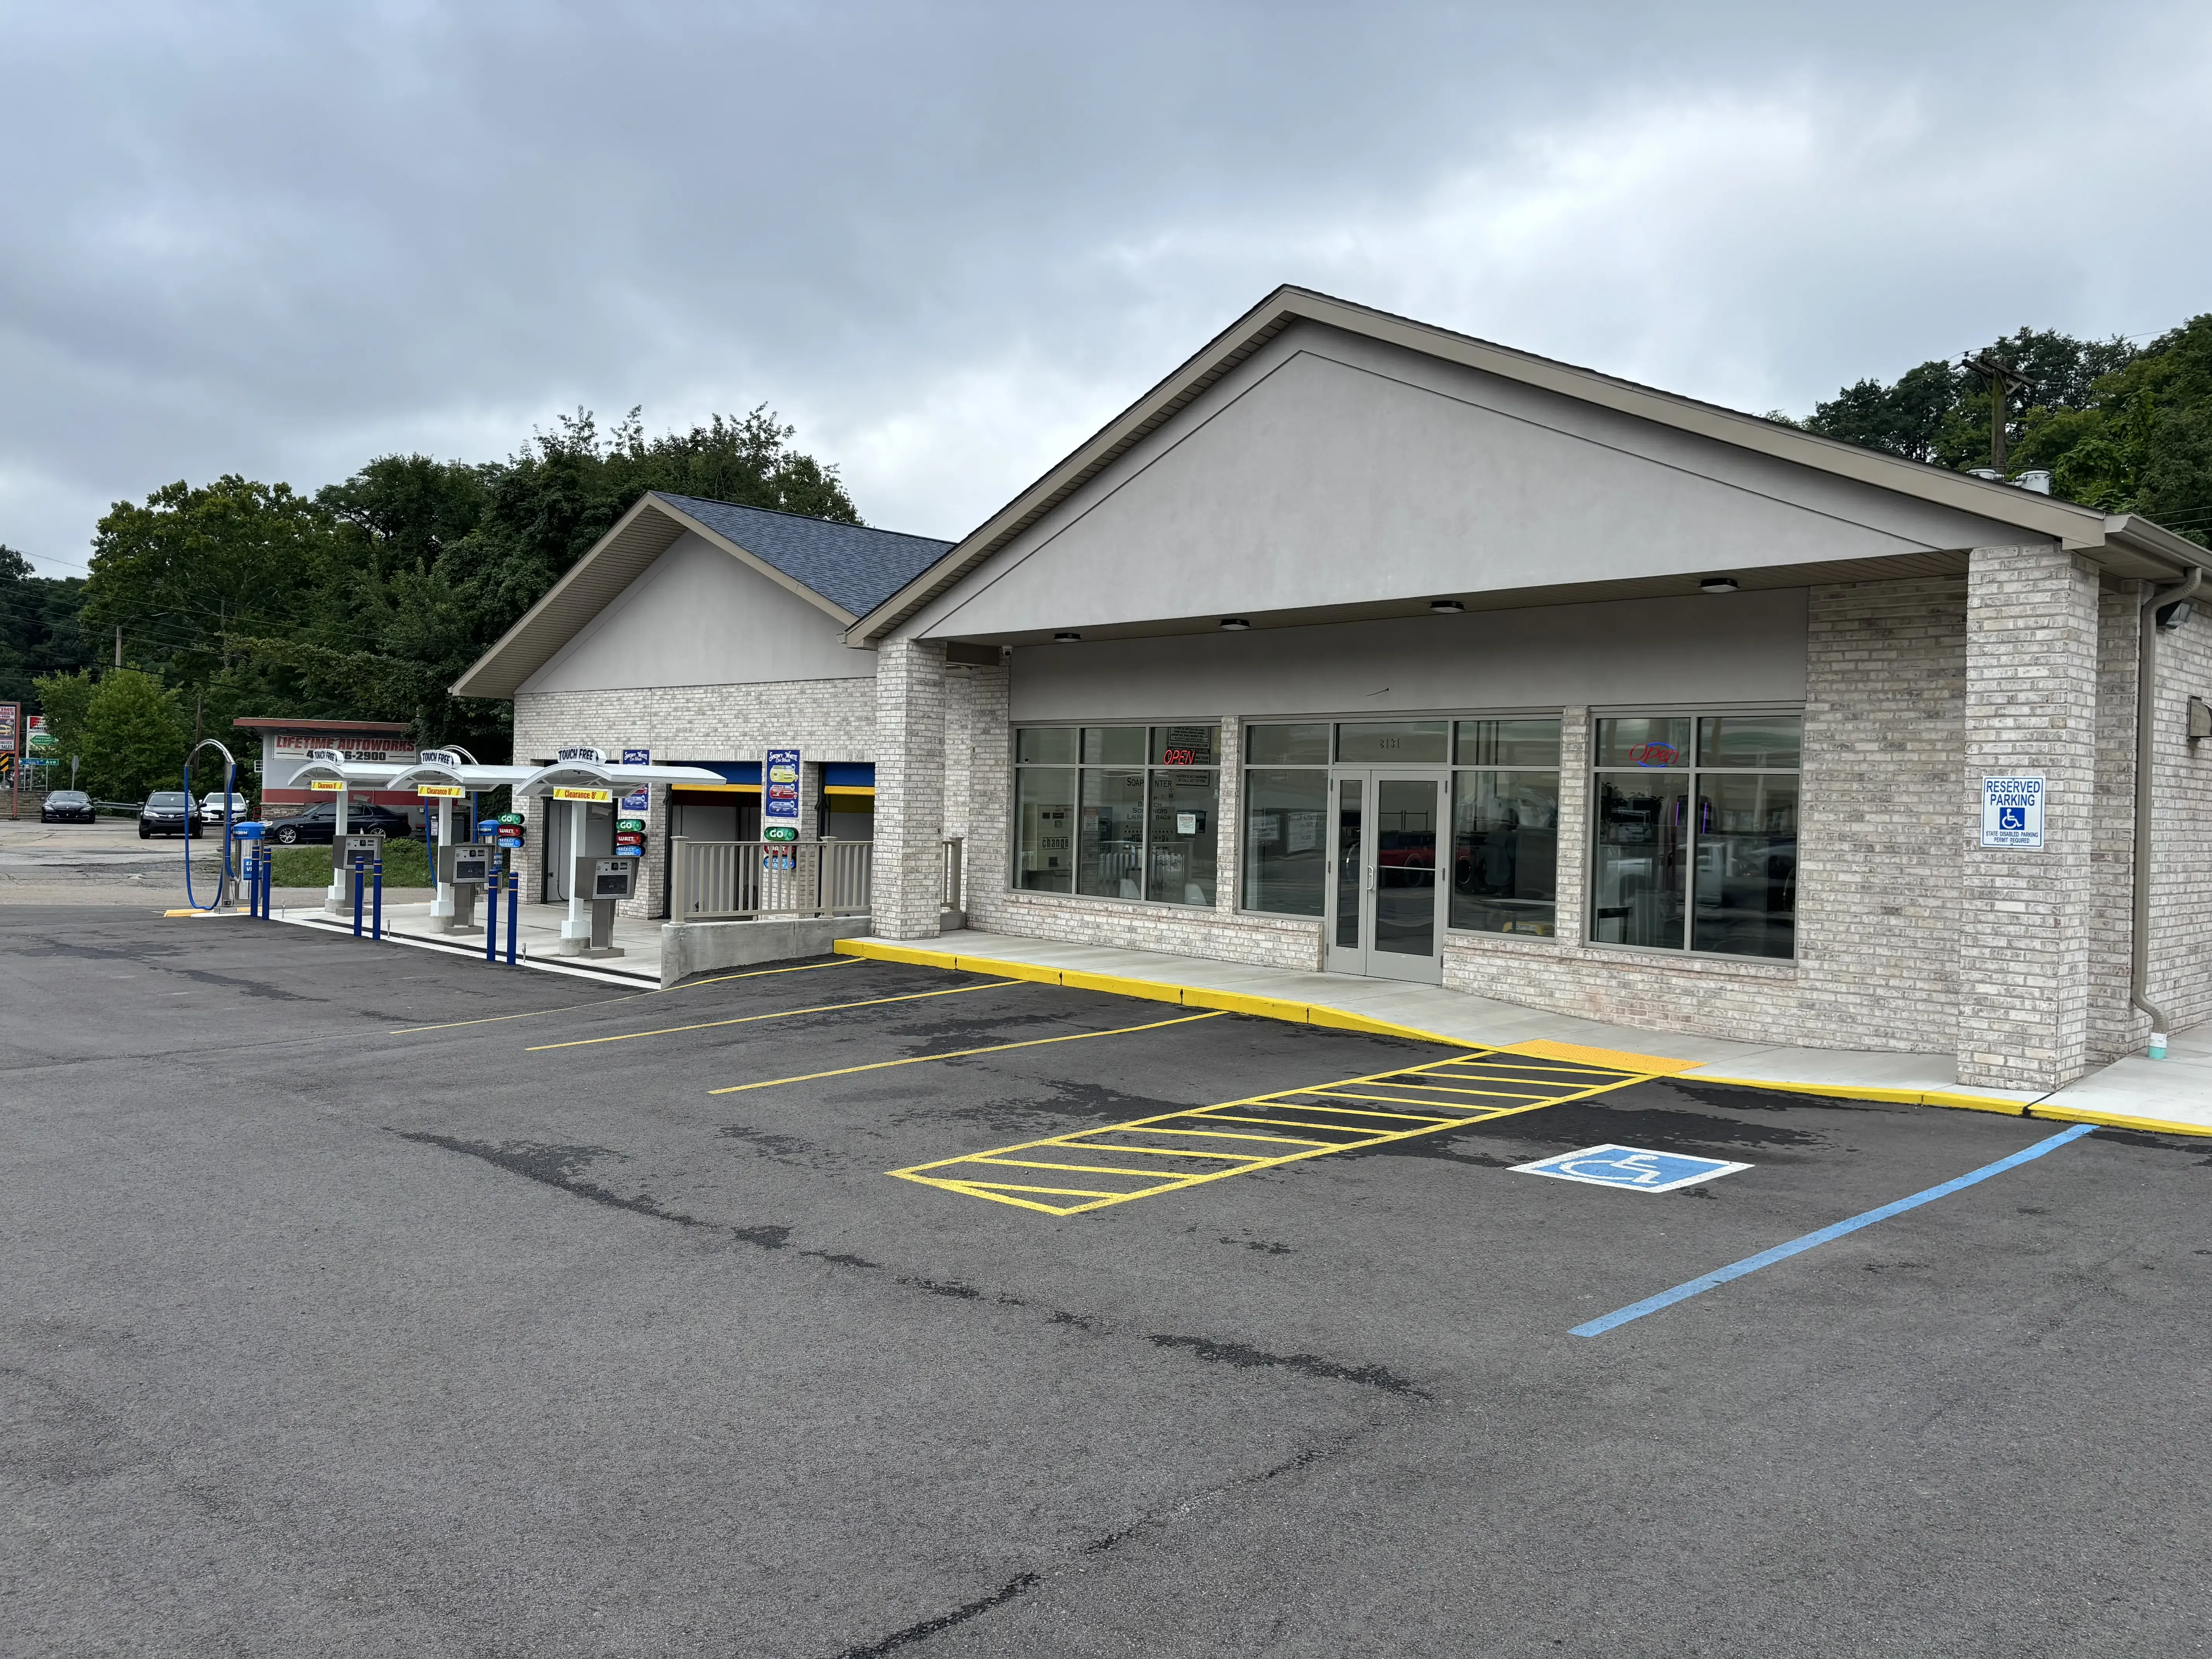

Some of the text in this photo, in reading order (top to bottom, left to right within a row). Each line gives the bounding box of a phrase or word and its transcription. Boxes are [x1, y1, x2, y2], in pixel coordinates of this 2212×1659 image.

[276, 736, 416, 752] LIFETIME AUTOWORKS
[314, 751, 335, 761] TOUCH FREE
[422, 752, 450, 764] TOUCH FREE
[558, 748, 594, 761] TOUCH FREE
[1164, 750, 1195, 764] OPEN
[1629, 743, 1679, 764] Open
[1127, 777, 1144, 787] SOAP
[1986, 781, 2040, 793] RESERVED
[565, 790, 590, 799] Clearance
[1990, 794, 2035, 806] PARKING
[501, 814, 512, 822] GO
[620, 820, 632, 829] GO
[769, 828, 783, 838] GO
[1042, 837, 1069, 849] change
